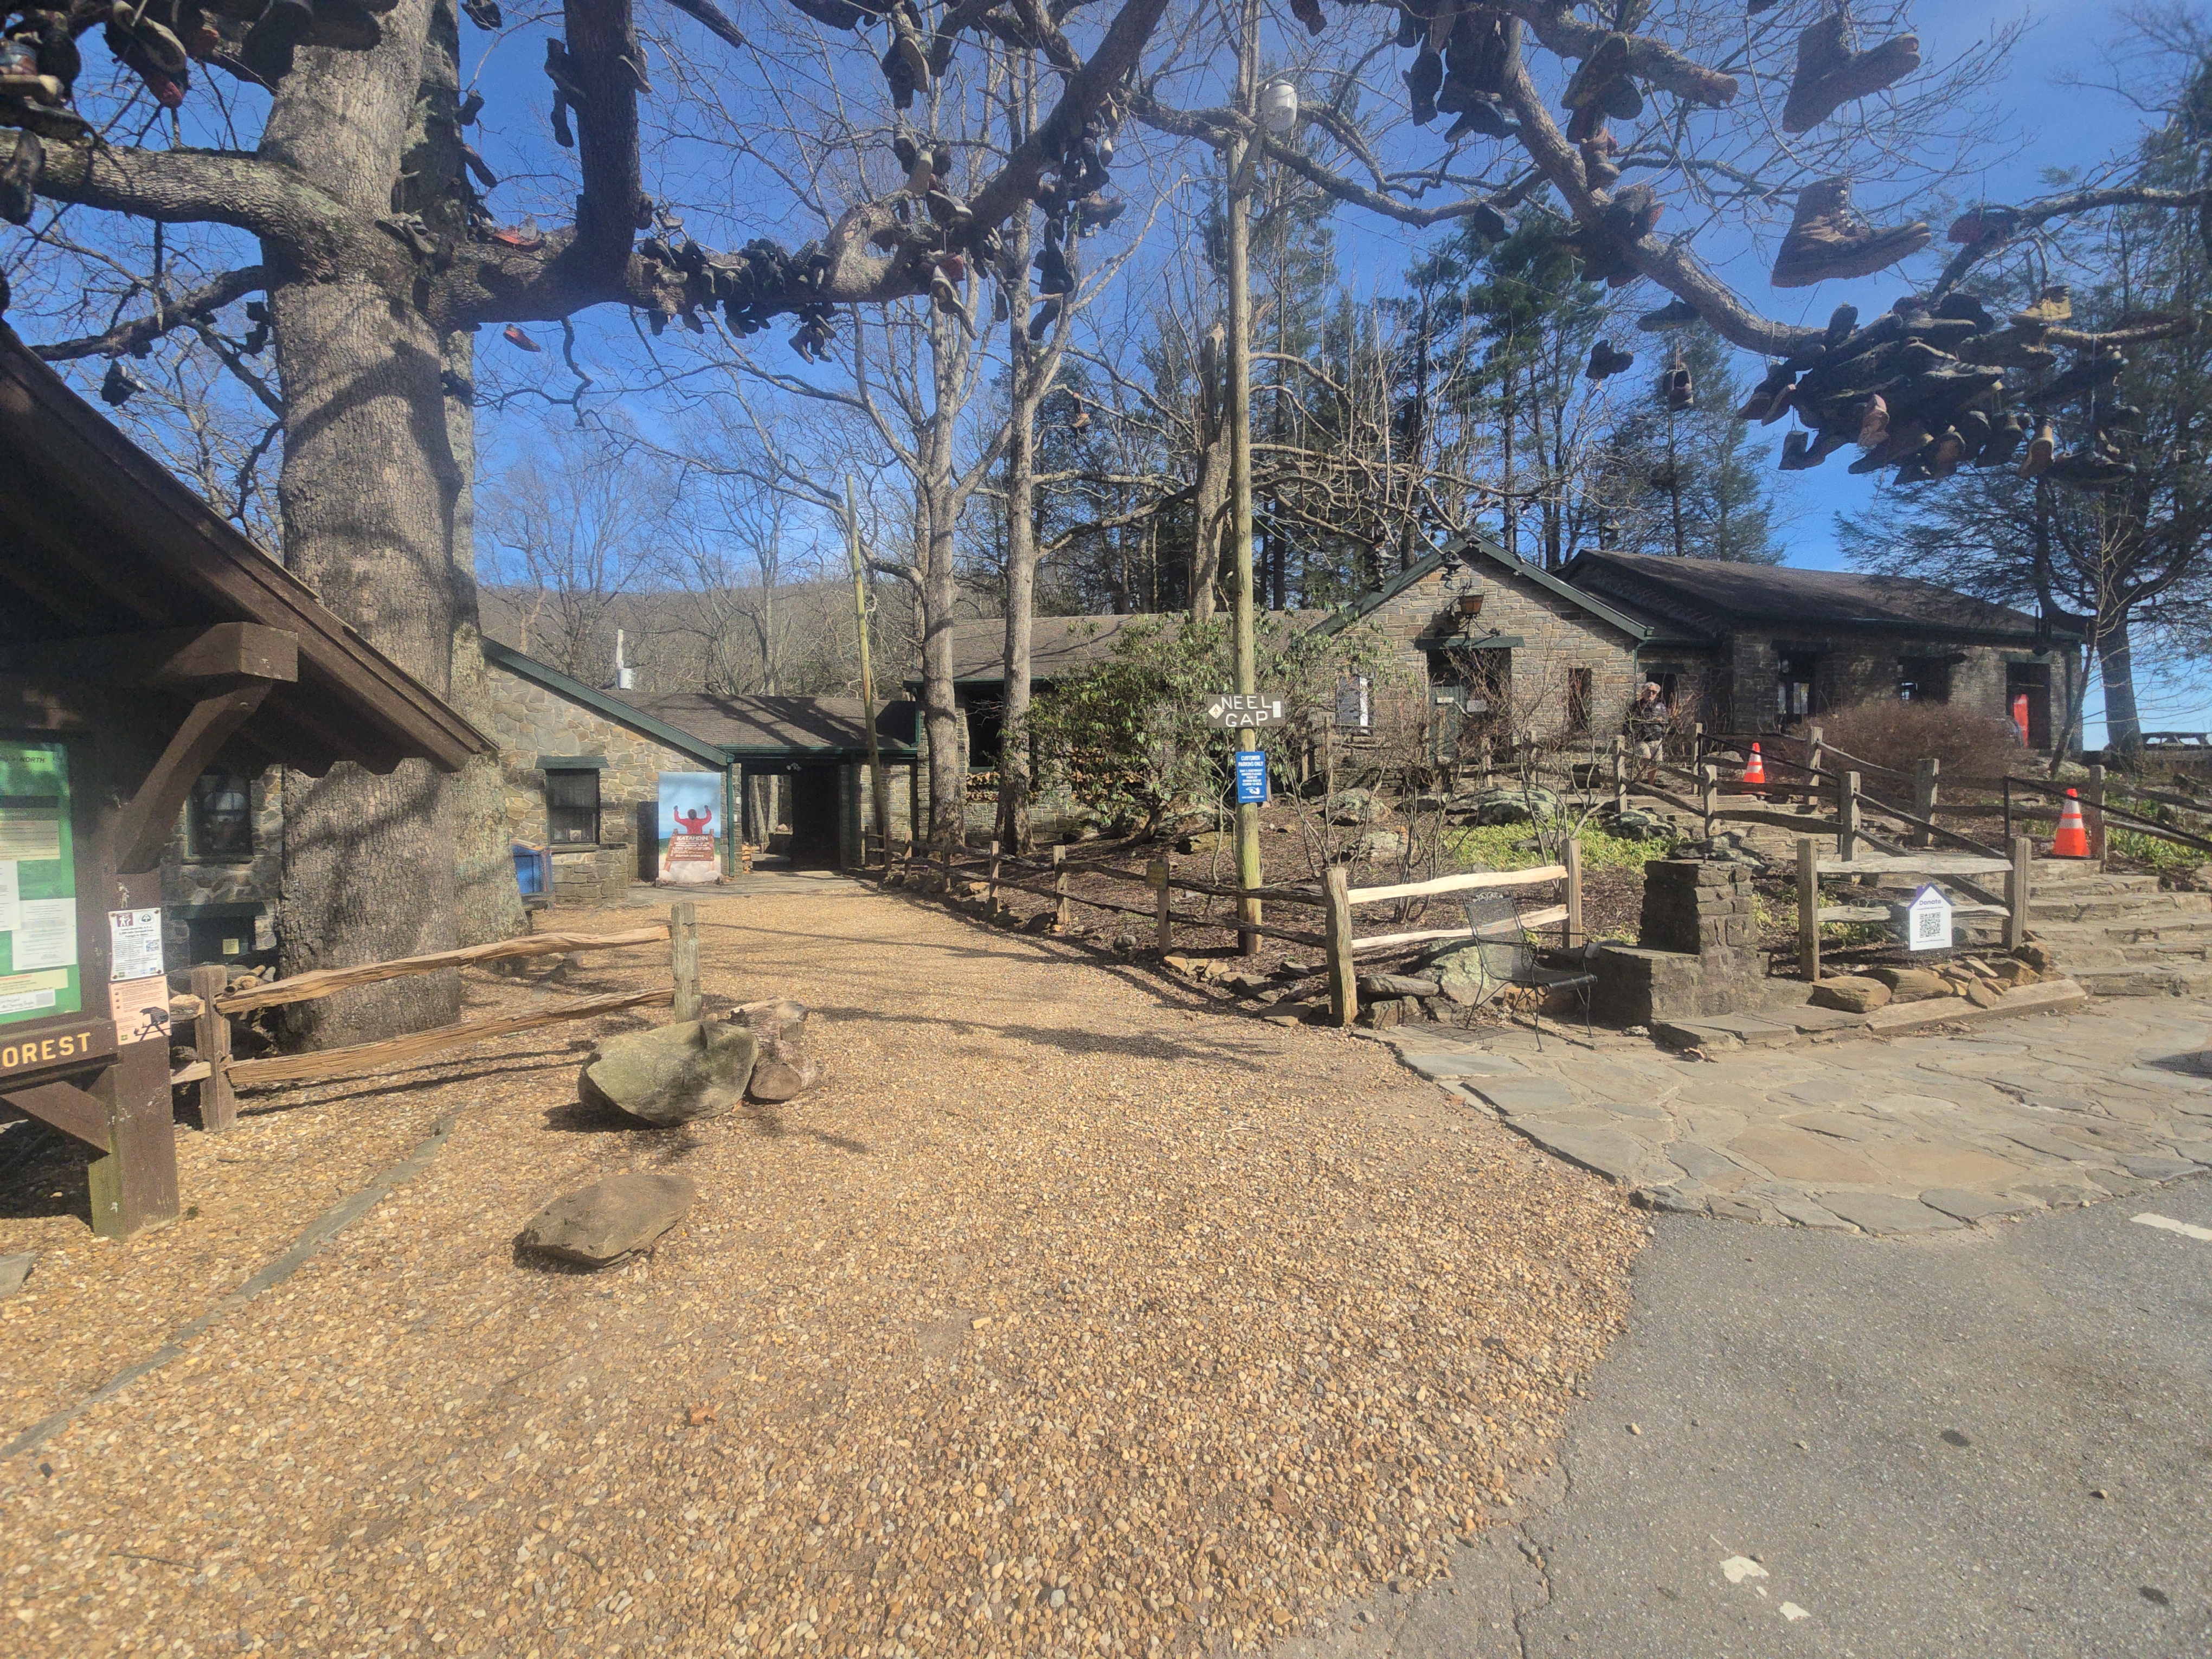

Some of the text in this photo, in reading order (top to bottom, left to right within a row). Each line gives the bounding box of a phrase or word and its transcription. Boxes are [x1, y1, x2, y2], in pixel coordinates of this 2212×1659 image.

[1221, 695, 1272, 710] NEEL
[1225, 710, 1269, 727] GAP
[2, 1032, 91, 1068] OREST
